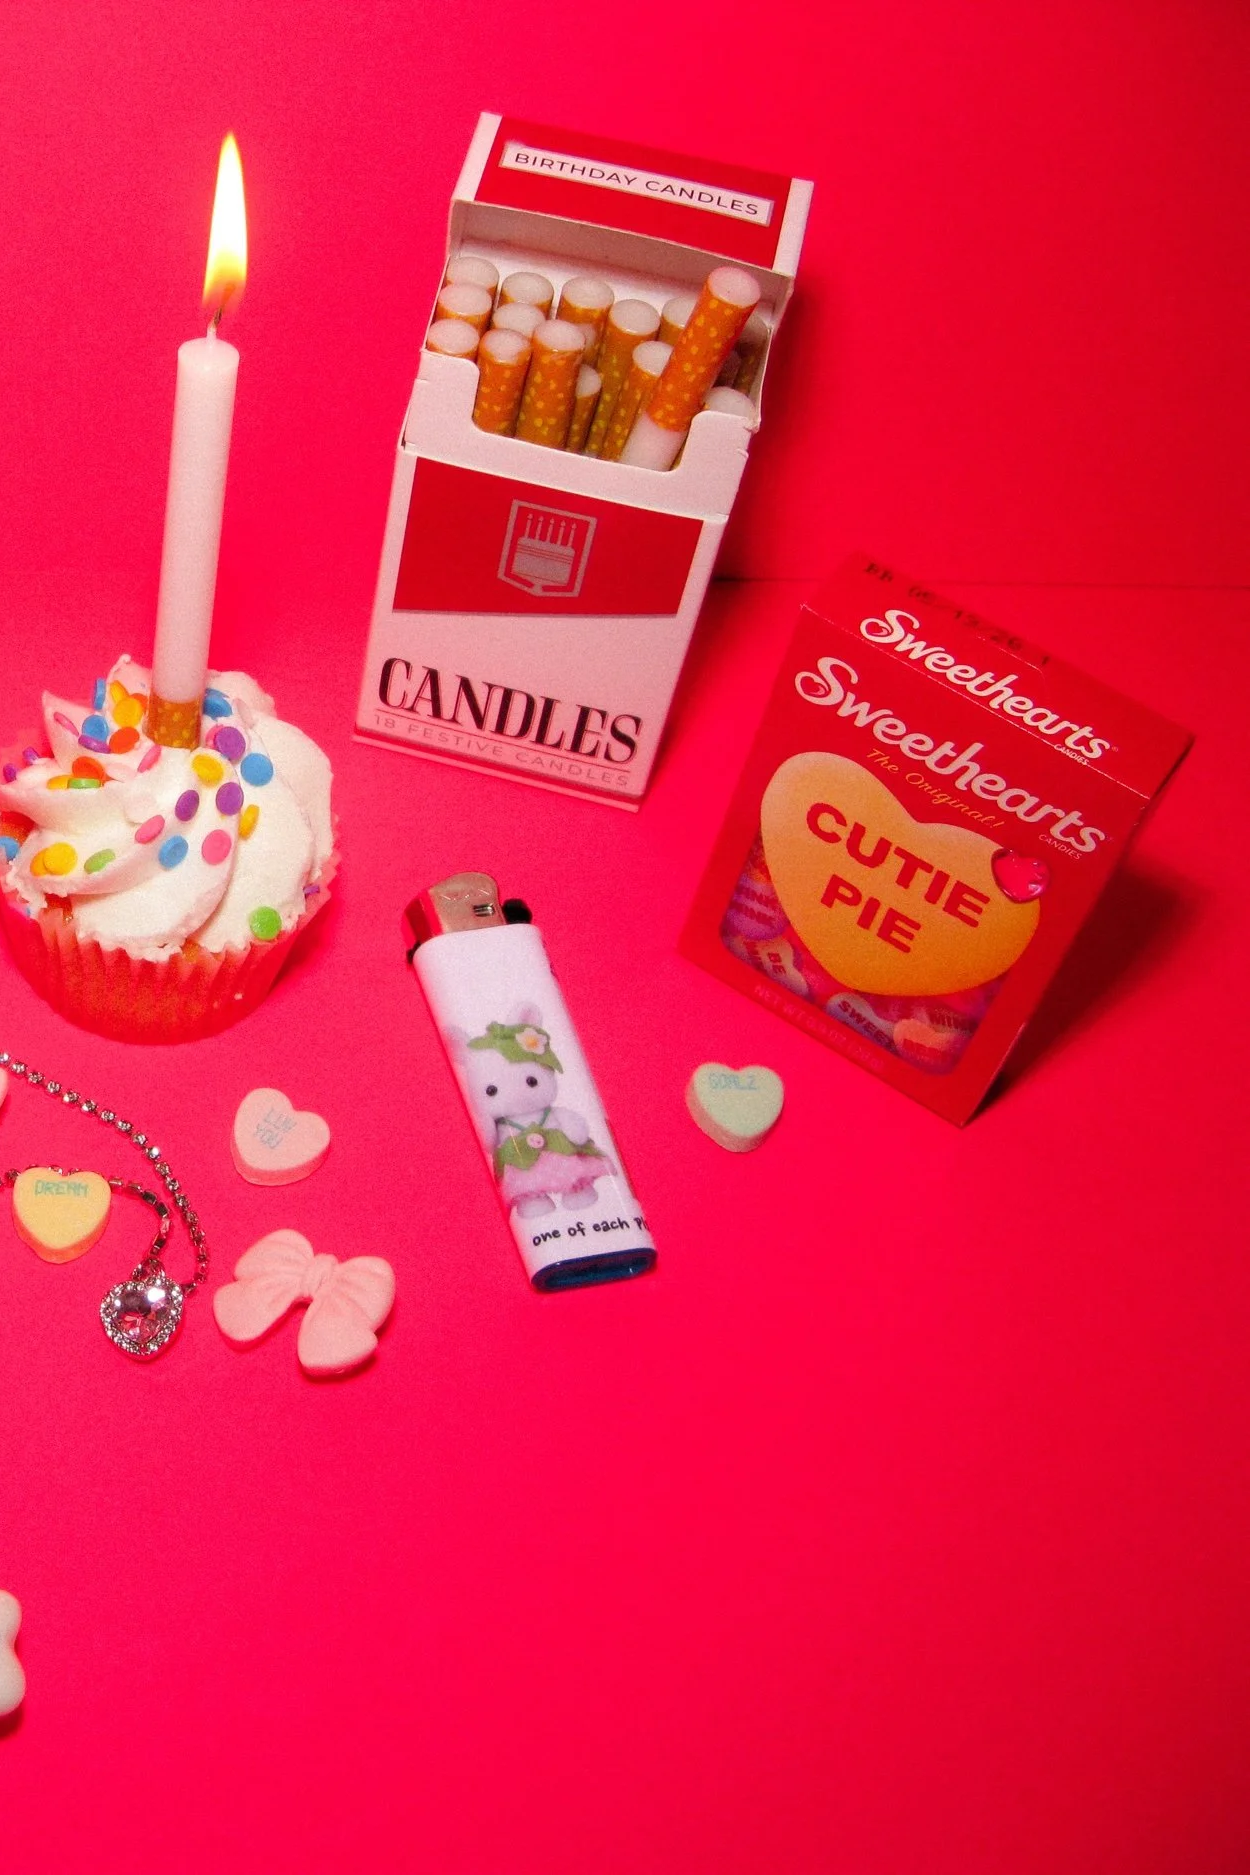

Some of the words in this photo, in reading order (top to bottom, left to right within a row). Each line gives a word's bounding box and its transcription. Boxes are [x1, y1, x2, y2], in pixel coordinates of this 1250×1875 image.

[514, 152, 638, 187] BIRTHDAY
[645, 180, 759, 216] CANDLES
[378, 657, 644, 765] CANDLES
[859, 609, 1111, 759] Sweethearts
[374, 714, 396, 729] 18
[408, 723, 504, 757] FESTIVE
[515, 751, 629, 787] CANDLES
[794, 656, 1106, 852] Sweethearts
[867, 748, 899, 774] The
[806, 802, 991, 928] CUTIE
[1038, 833, 1083, 860] CANDIES
[820, 873, 922, 953] PIE
[34, 1180, 89, 1198] DREAM
[532, 1229, 562, 1247] one
[567, 1221, 587, 1237] of
[592, 1217, 631, 1233] each
